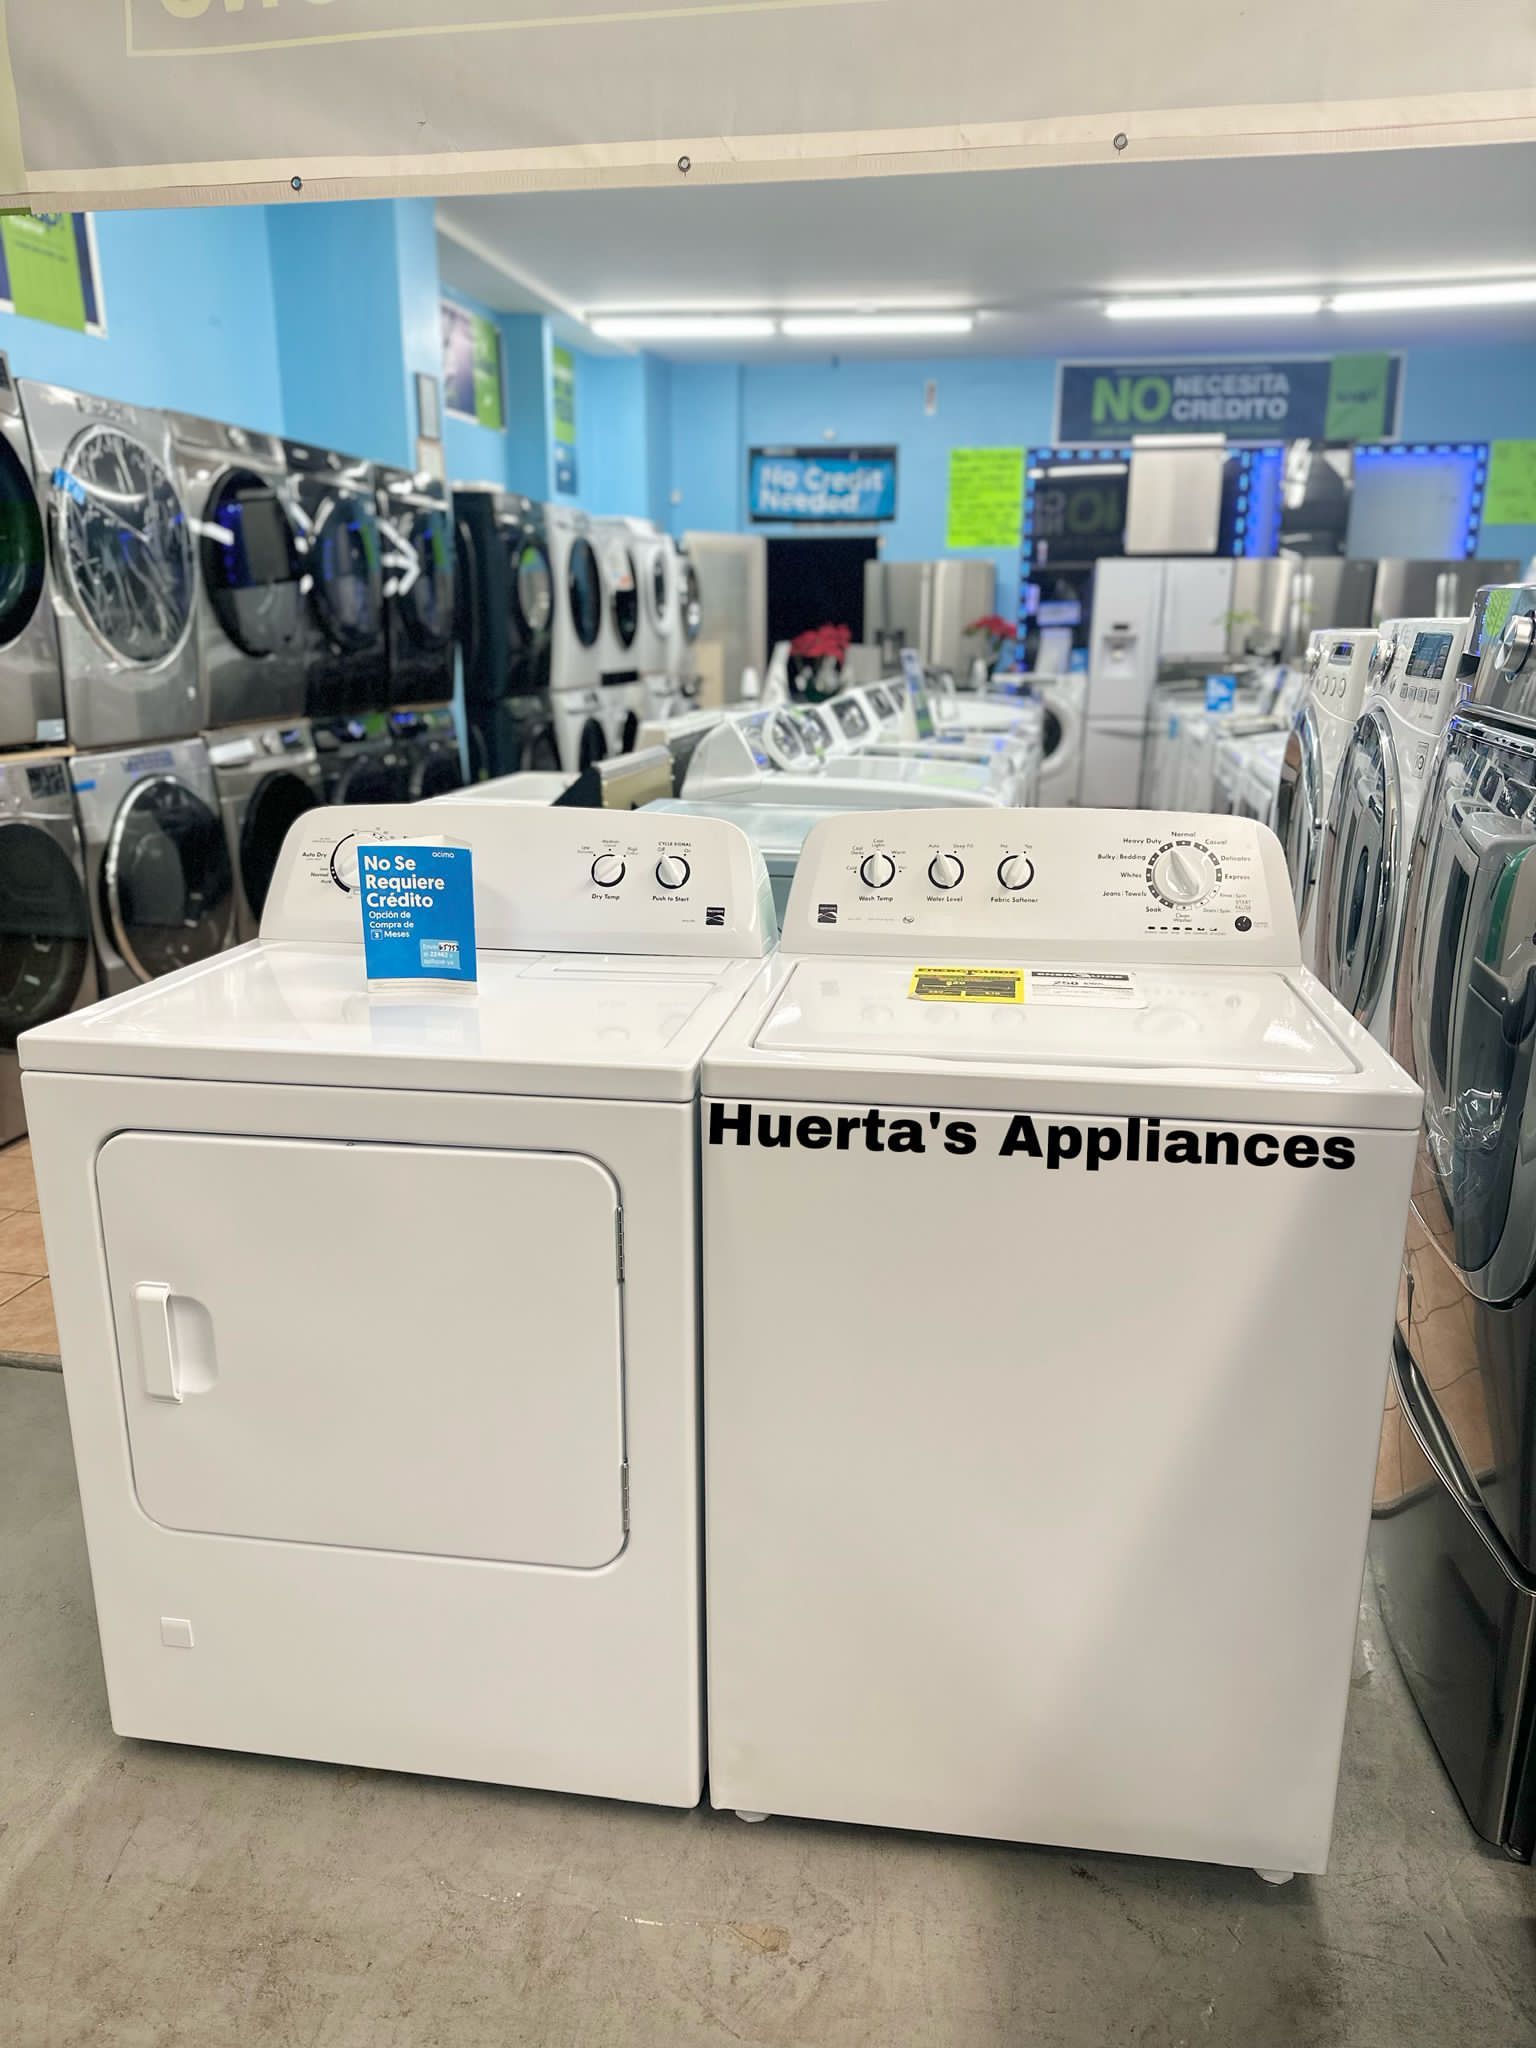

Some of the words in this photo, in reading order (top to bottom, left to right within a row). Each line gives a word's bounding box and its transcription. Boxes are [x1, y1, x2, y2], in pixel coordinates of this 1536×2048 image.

[1092, 376, 1172, 423] NO
[1173, 373, 1289, 396] NECESITA
[761, 465, 798, 490] No
[804, 465, 883, 491] Credit
[760, 490, 859, 512] Needed
[363, 855, 391, 871] No
[394, 855, 417, 871] Se
[365, 874, 445, 893] Requiere
[366, 892, 434, 908] Crédito
[604, 893, 620, 901] Temp
[368, 910, 399, 920] Opción
[400, 911, 412, 919] de
[369, 921, 401, 929] Compra
[384, 930, 410, 938] Meses
